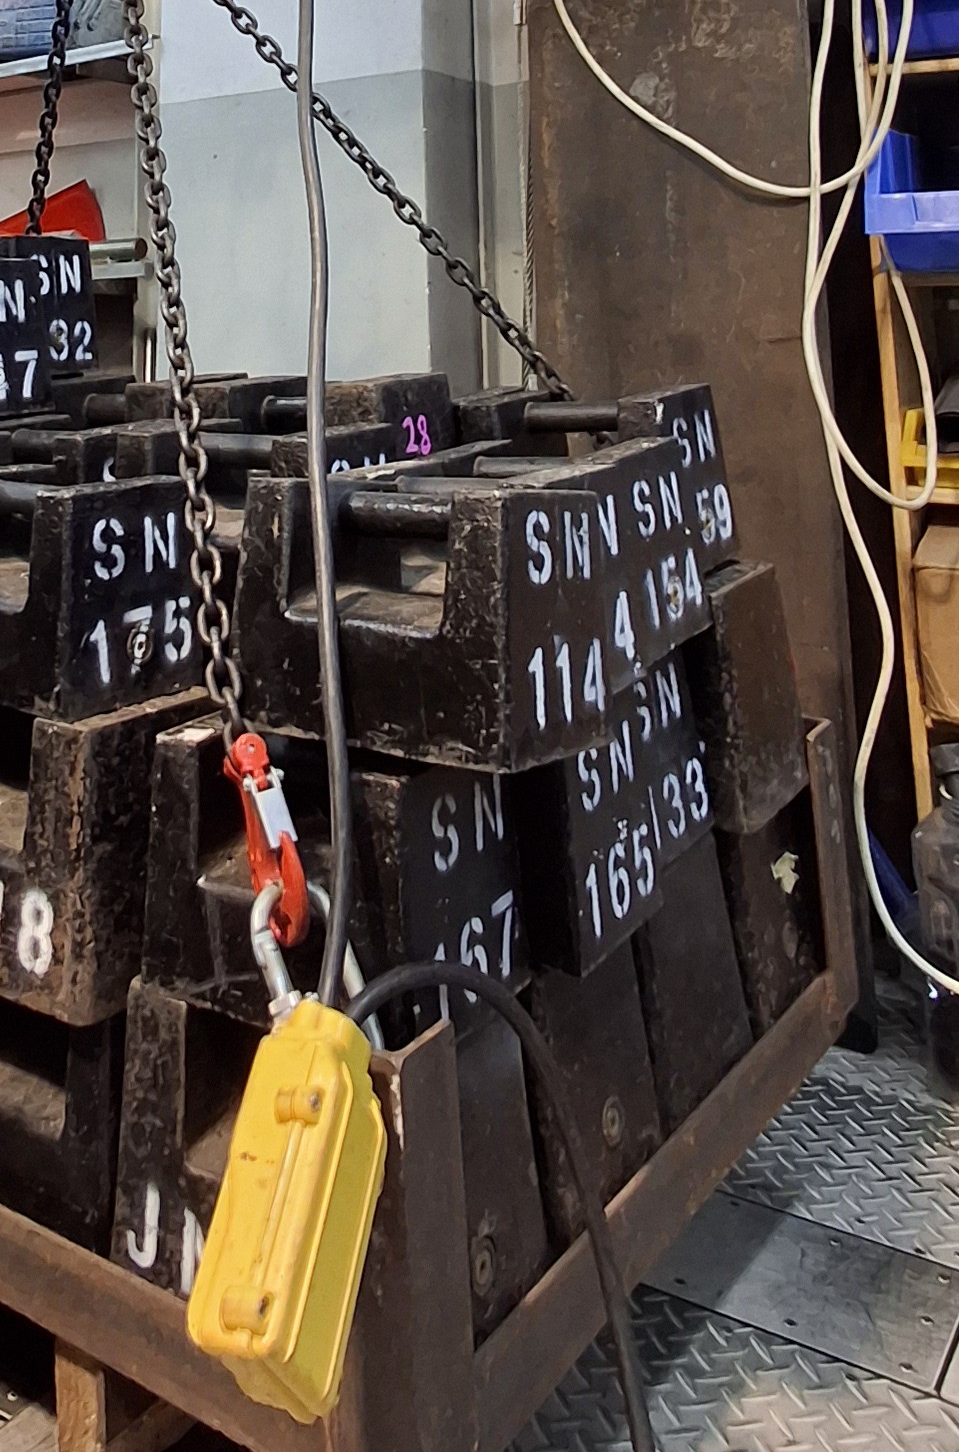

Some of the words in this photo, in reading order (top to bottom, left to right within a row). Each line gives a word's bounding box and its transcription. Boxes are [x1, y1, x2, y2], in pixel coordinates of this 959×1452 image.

[402, 414, 432, 456] 28
[672, 410, 716, 468] SN
[632, 471, 683, 539] SN
[92, 512, 177, 580] SN
[525, 510, 591, 585] SN
[528, 638, 605, 730] 114
[577, 720, 634, 812] SN
[432, 774, 504, 871] SN
[586, 823, 655, 939] 165
